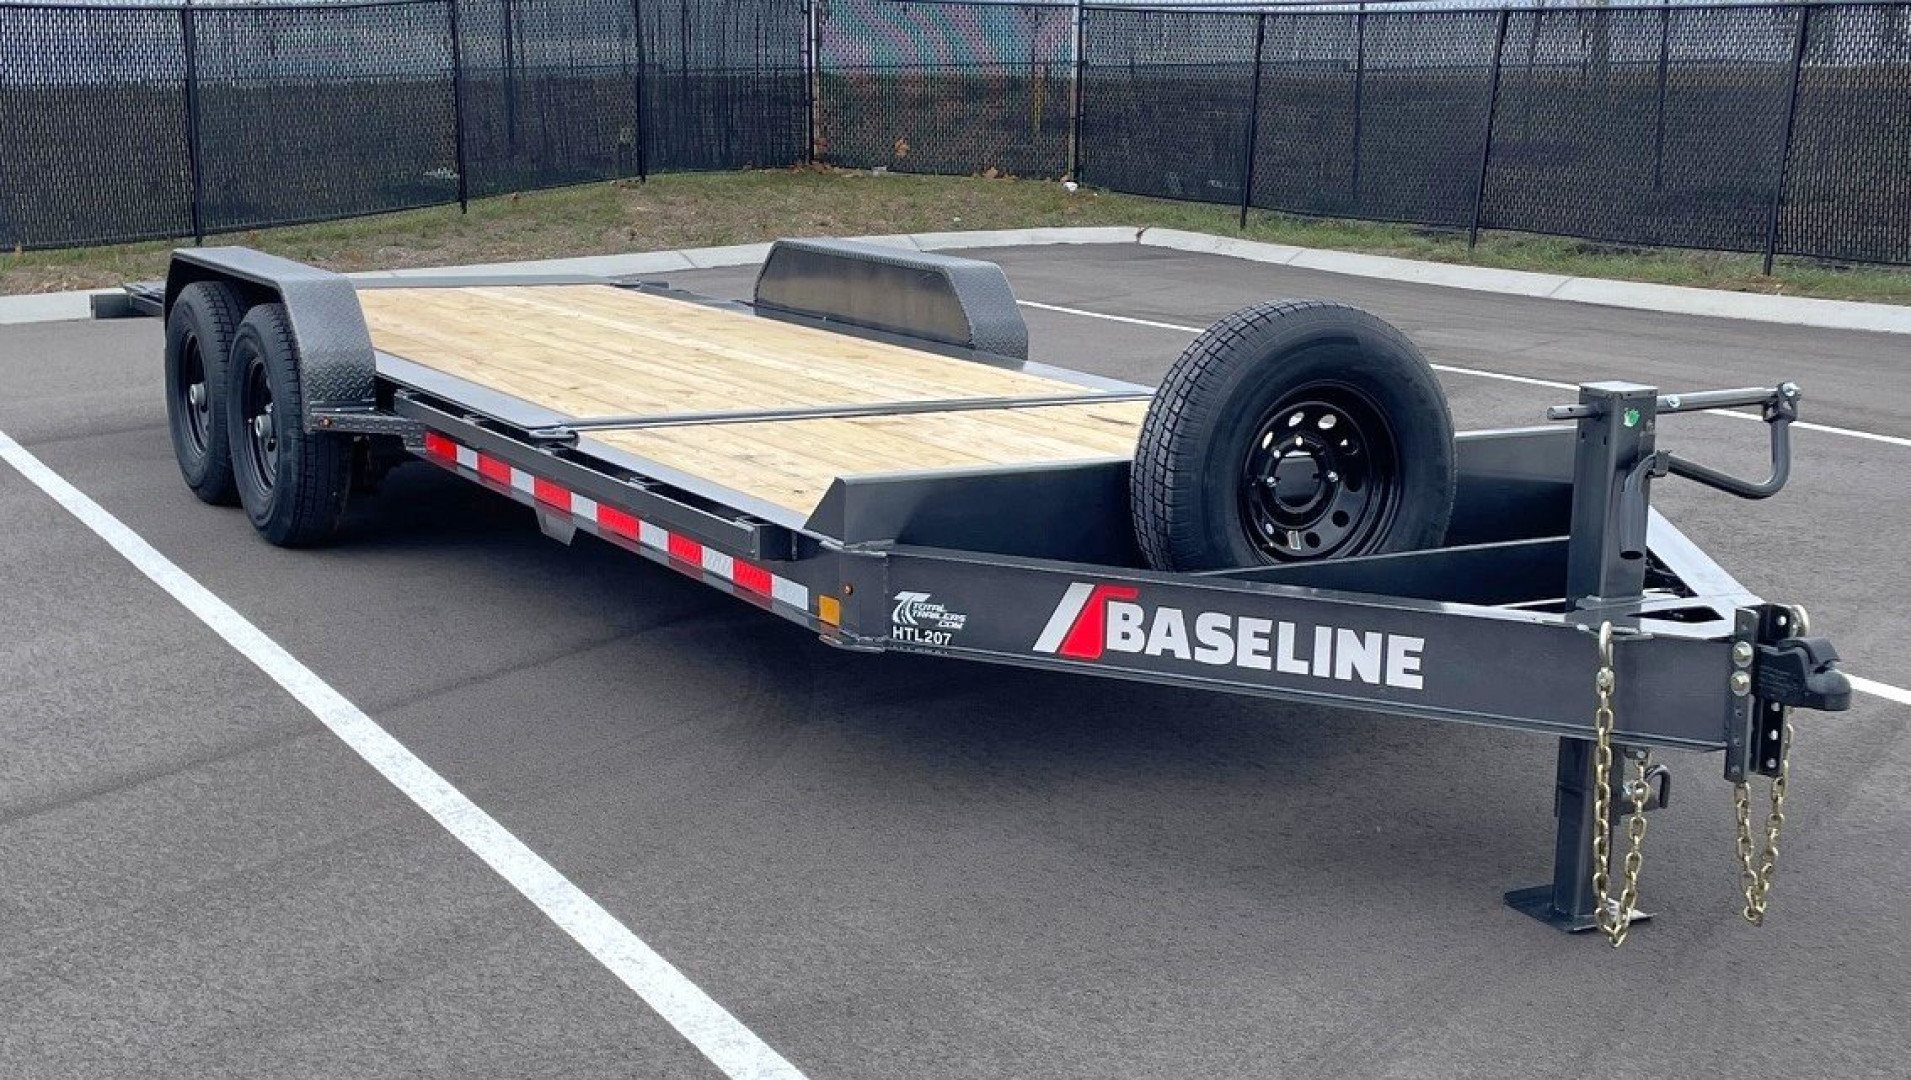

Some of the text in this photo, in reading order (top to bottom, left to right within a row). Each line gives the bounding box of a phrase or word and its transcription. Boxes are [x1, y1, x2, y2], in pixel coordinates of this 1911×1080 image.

[912, 602, 946, 612] TOTAL
[912, 610, 967, 622] TRAILERS
[892, 626, 952, 646] HTL207
[1106, 600, 1425, 689] BASELINE
